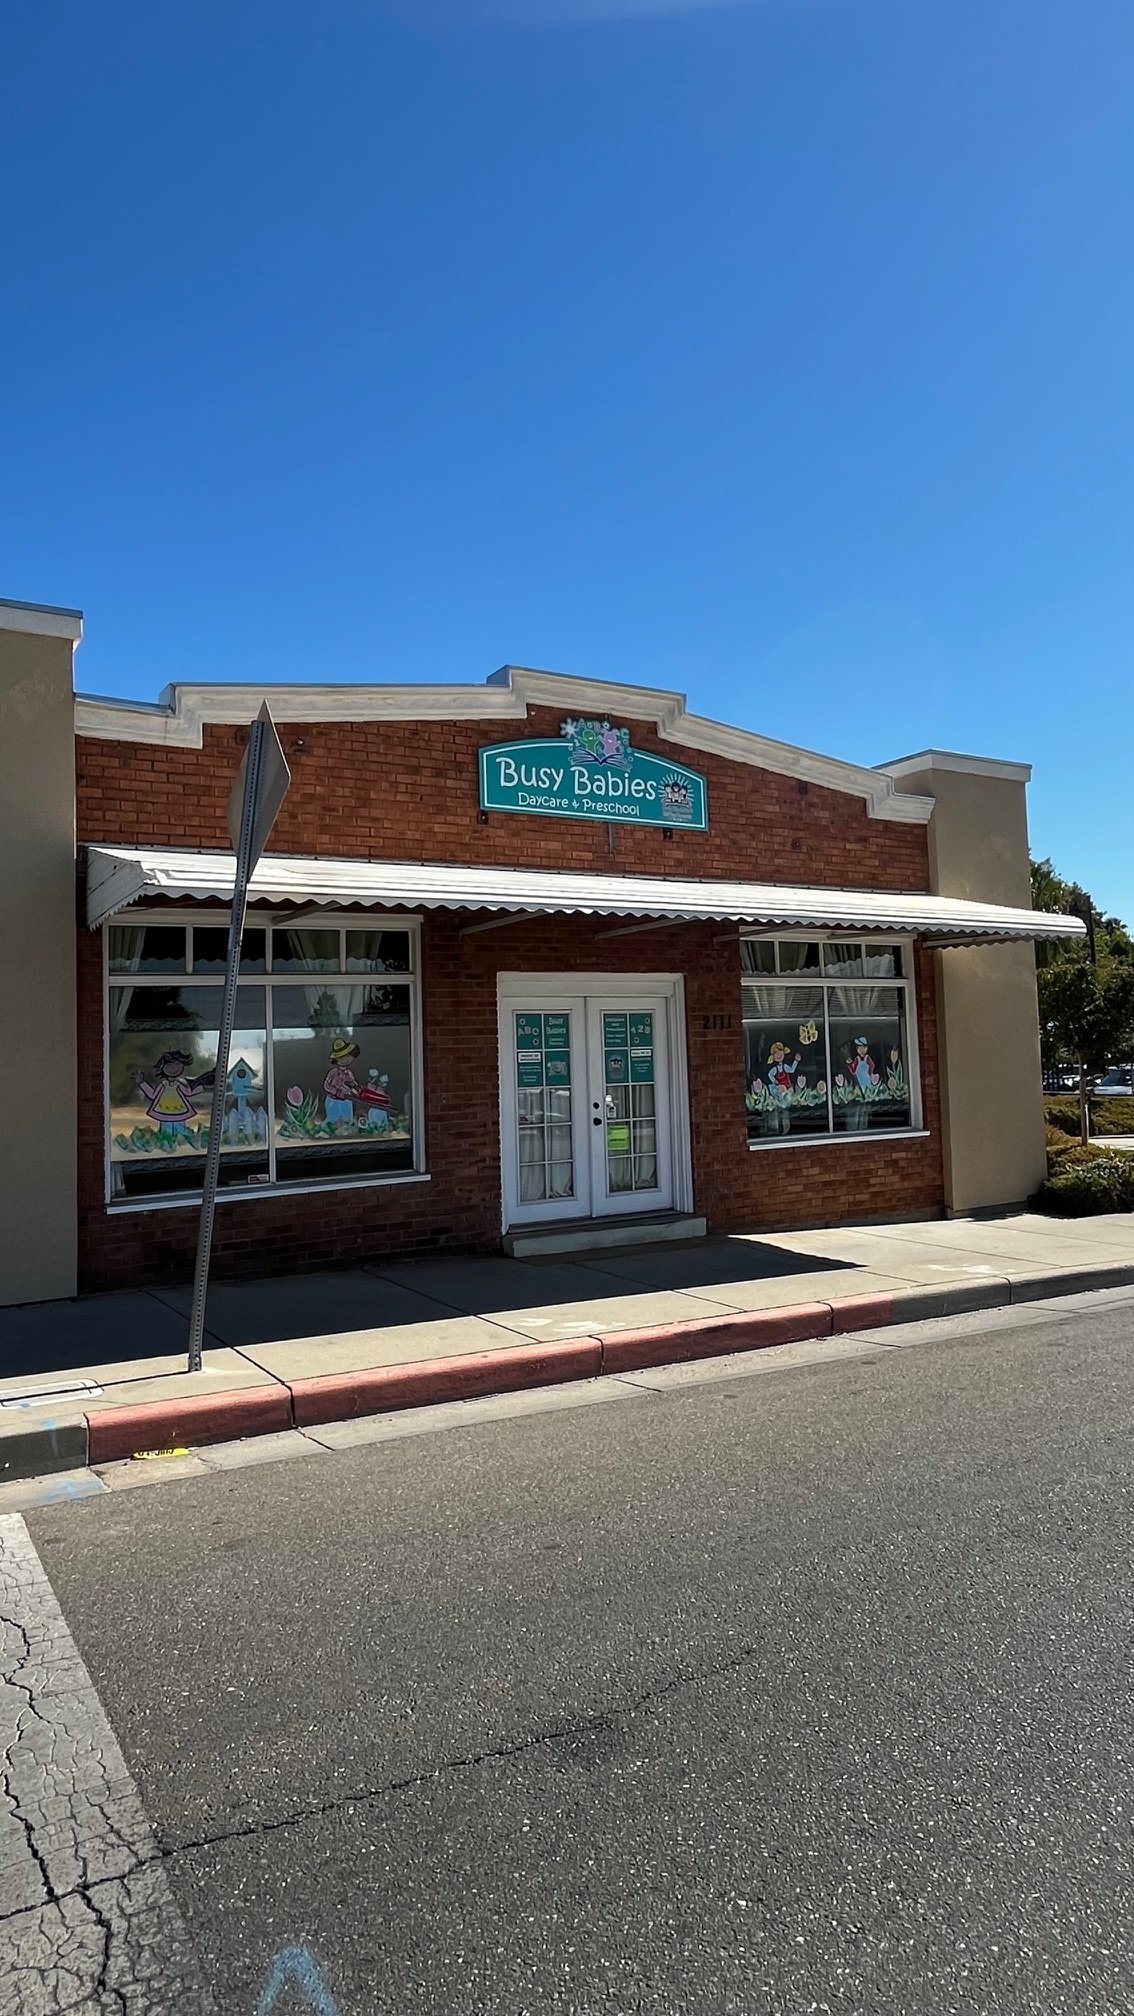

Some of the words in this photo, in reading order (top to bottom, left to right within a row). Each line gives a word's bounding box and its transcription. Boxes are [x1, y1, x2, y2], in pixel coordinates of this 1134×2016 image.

[496, 757, 564, 791] Busy
[570, 766, 657, 800] Babies
[518, 792, 568, 809] Daycare
[582, 799, 640, 817] Preschool
